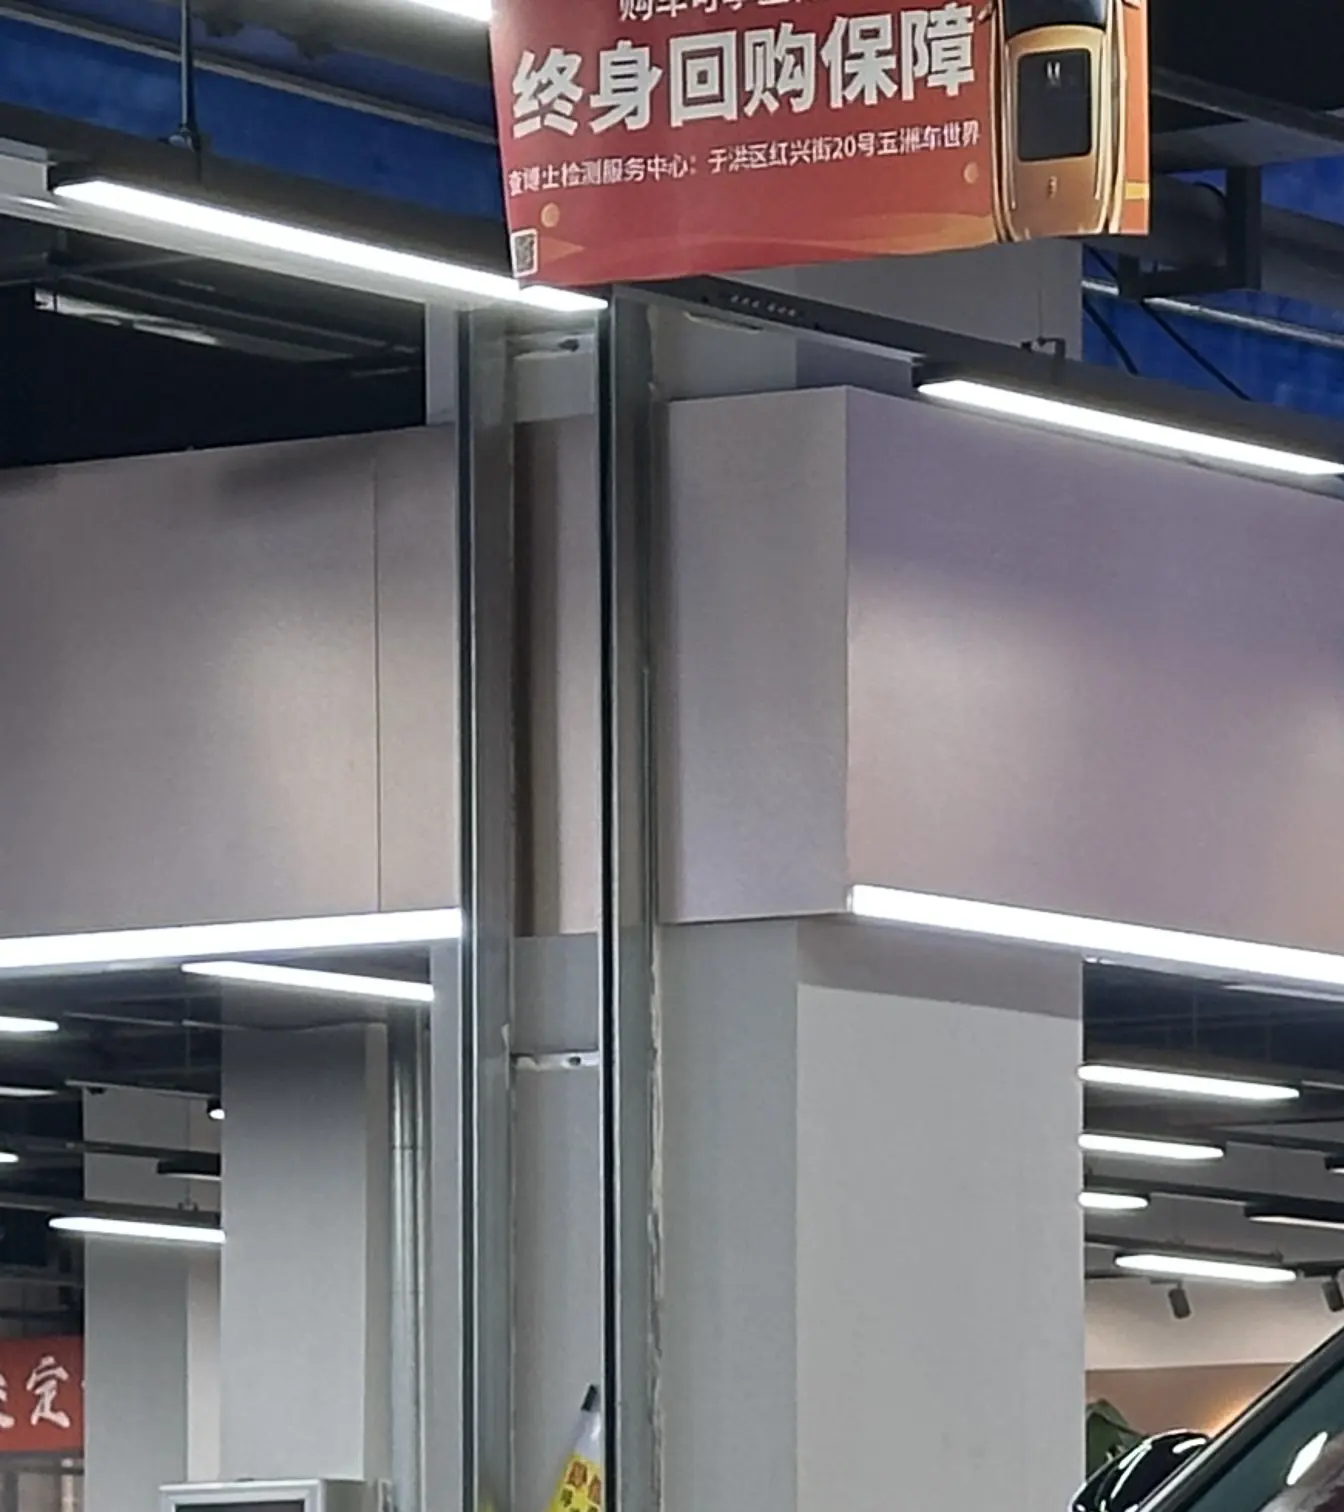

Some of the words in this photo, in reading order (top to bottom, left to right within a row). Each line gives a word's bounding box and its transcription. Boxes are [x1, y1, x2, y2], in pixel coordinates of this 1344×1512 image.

[512, 3, 975, 139] 终身回购保障
[0, 1355, 70, 1429] 定
